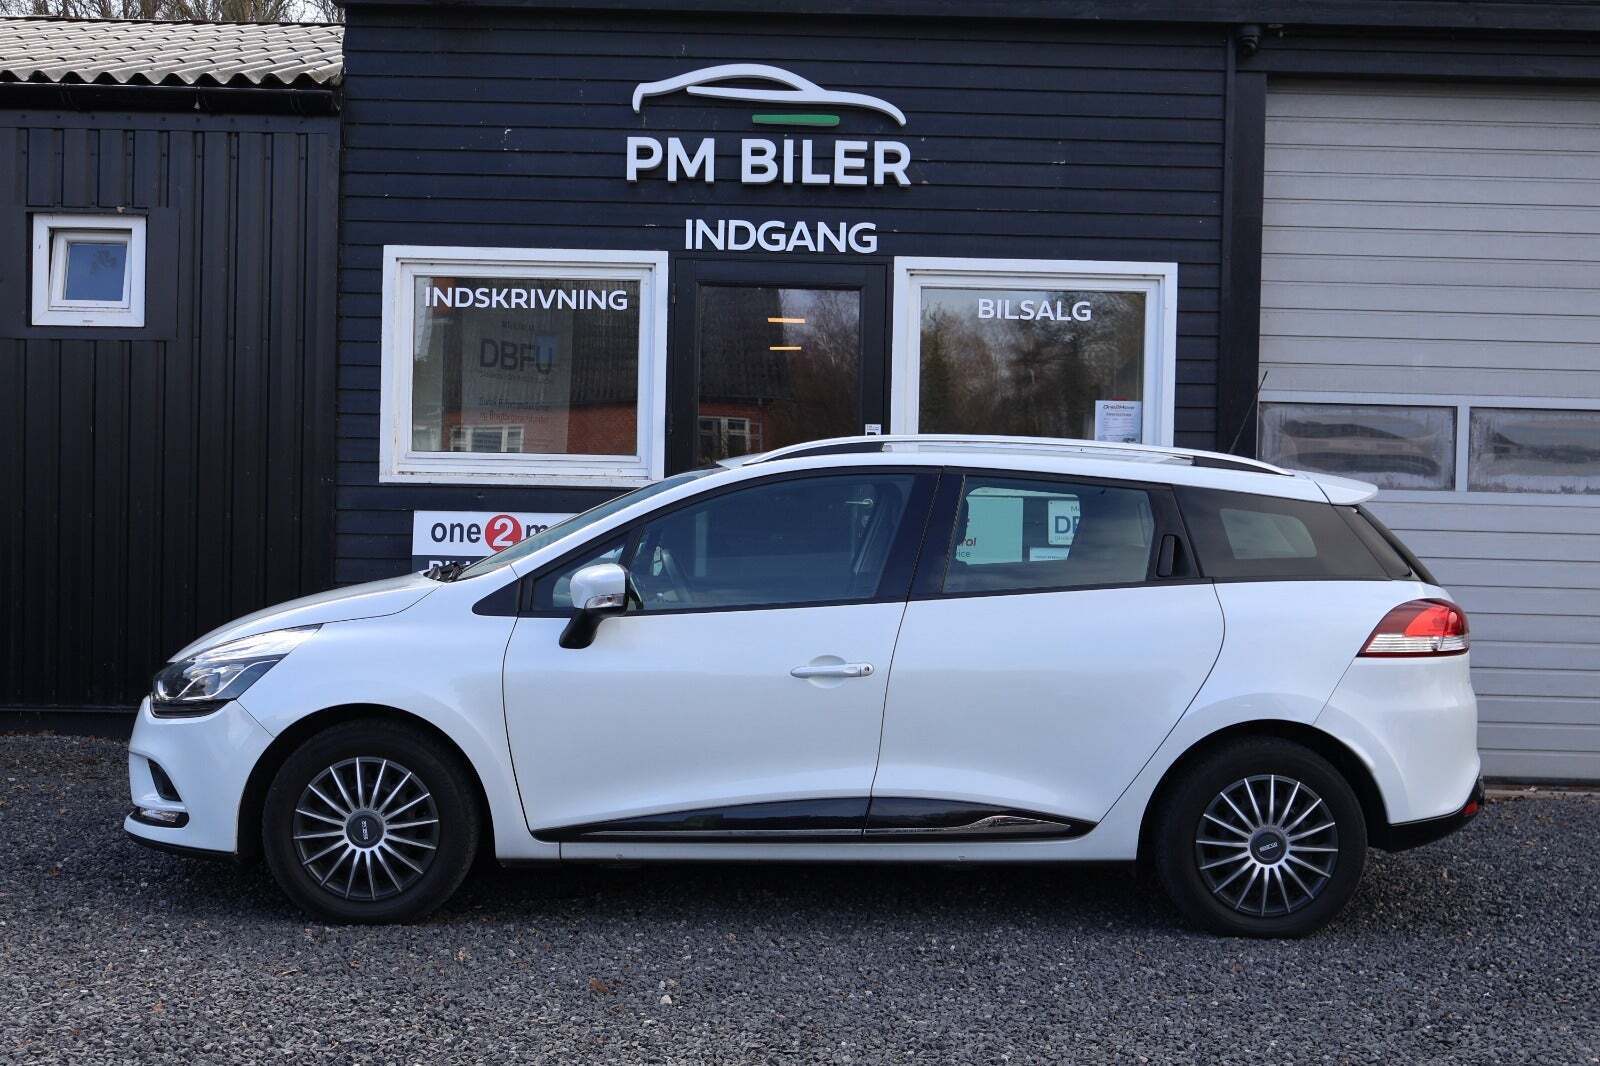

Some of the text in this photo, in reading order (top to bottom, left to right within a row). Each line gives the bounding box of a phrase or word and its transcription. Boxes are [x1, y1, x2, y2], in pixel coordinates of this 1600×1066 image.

[626, 136, 911, 186] PM BILER
[685, 218, 878, 254] INDGANG
[425, 286, 628, 311] INDSKRIVNING
[977, 298, 1092, 322] BILSALG
